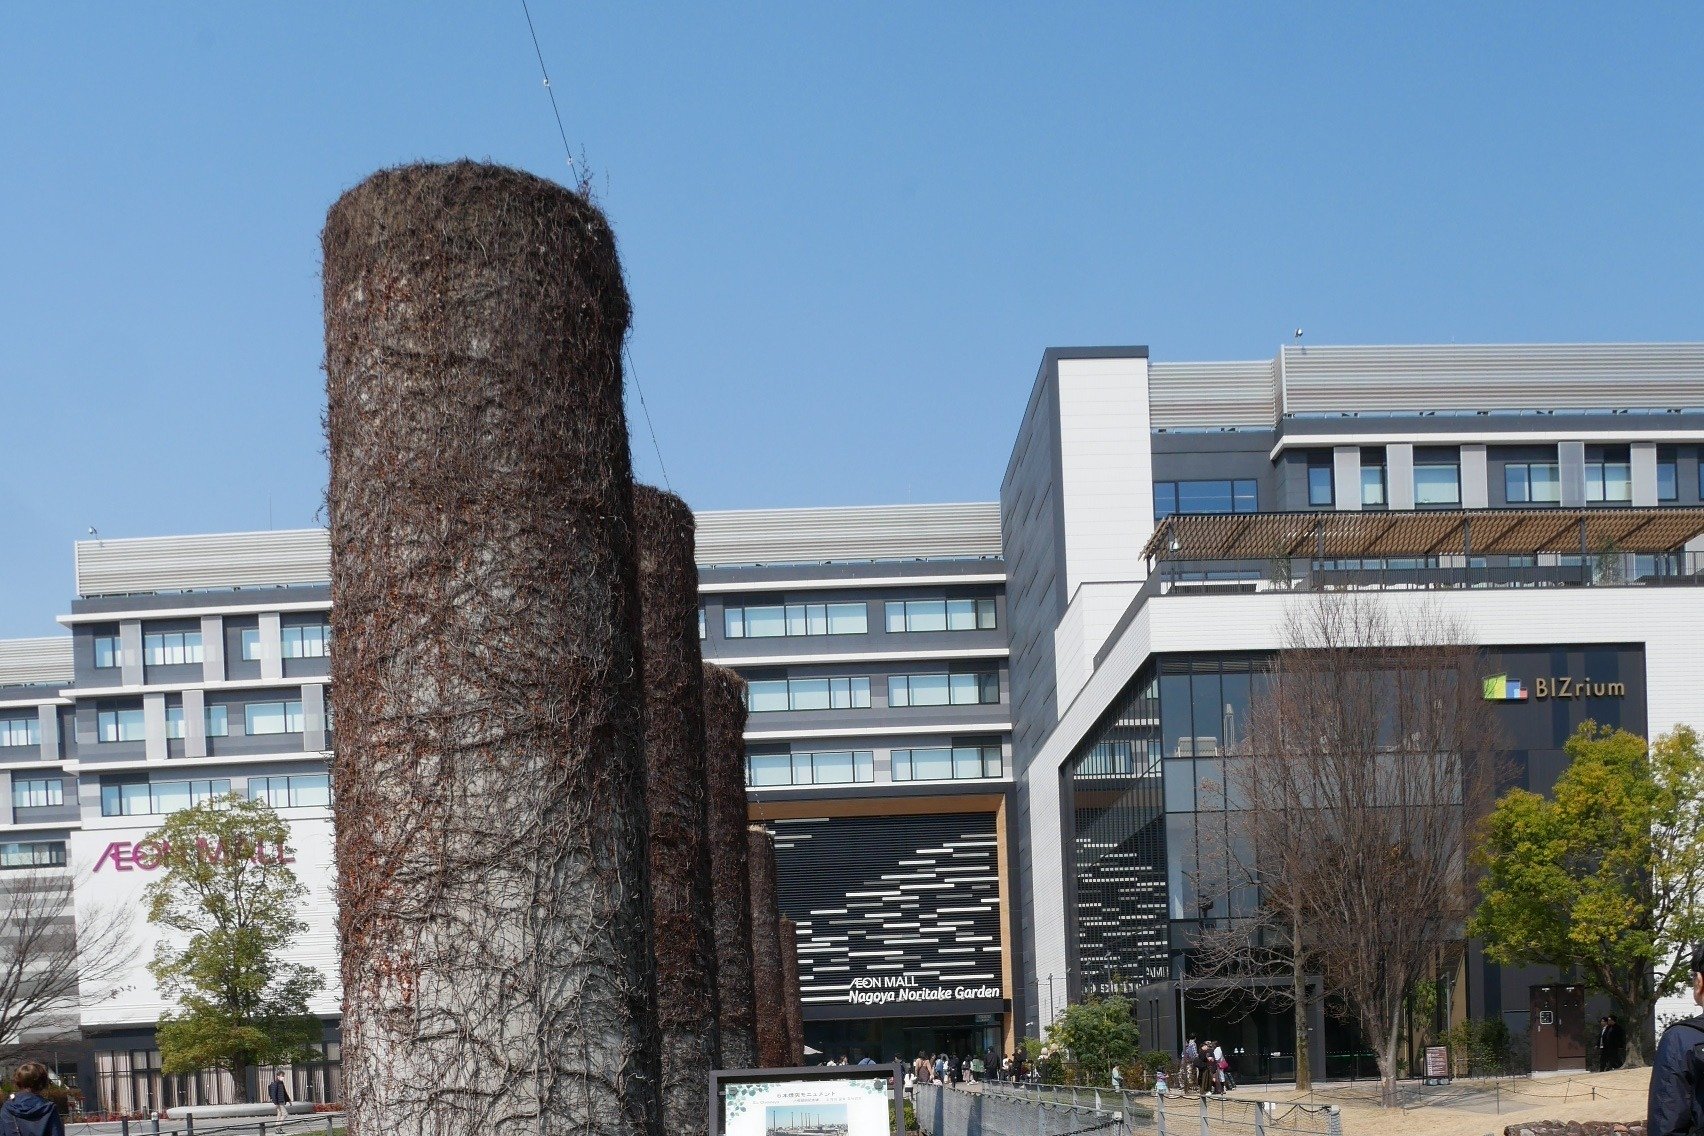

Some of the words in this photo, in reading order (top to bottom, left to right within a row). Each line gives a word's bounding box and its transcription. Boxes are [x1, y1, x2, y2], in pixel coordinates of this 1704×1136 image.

[1536, 677, 1625, 698] BIZrium
[885, 976, 918, 988] MALL
[848, 989, 895, 1005] Nagoya
[898, 987, 952, 1002] Noritake
[955, 985, 1000, 999] Garden
